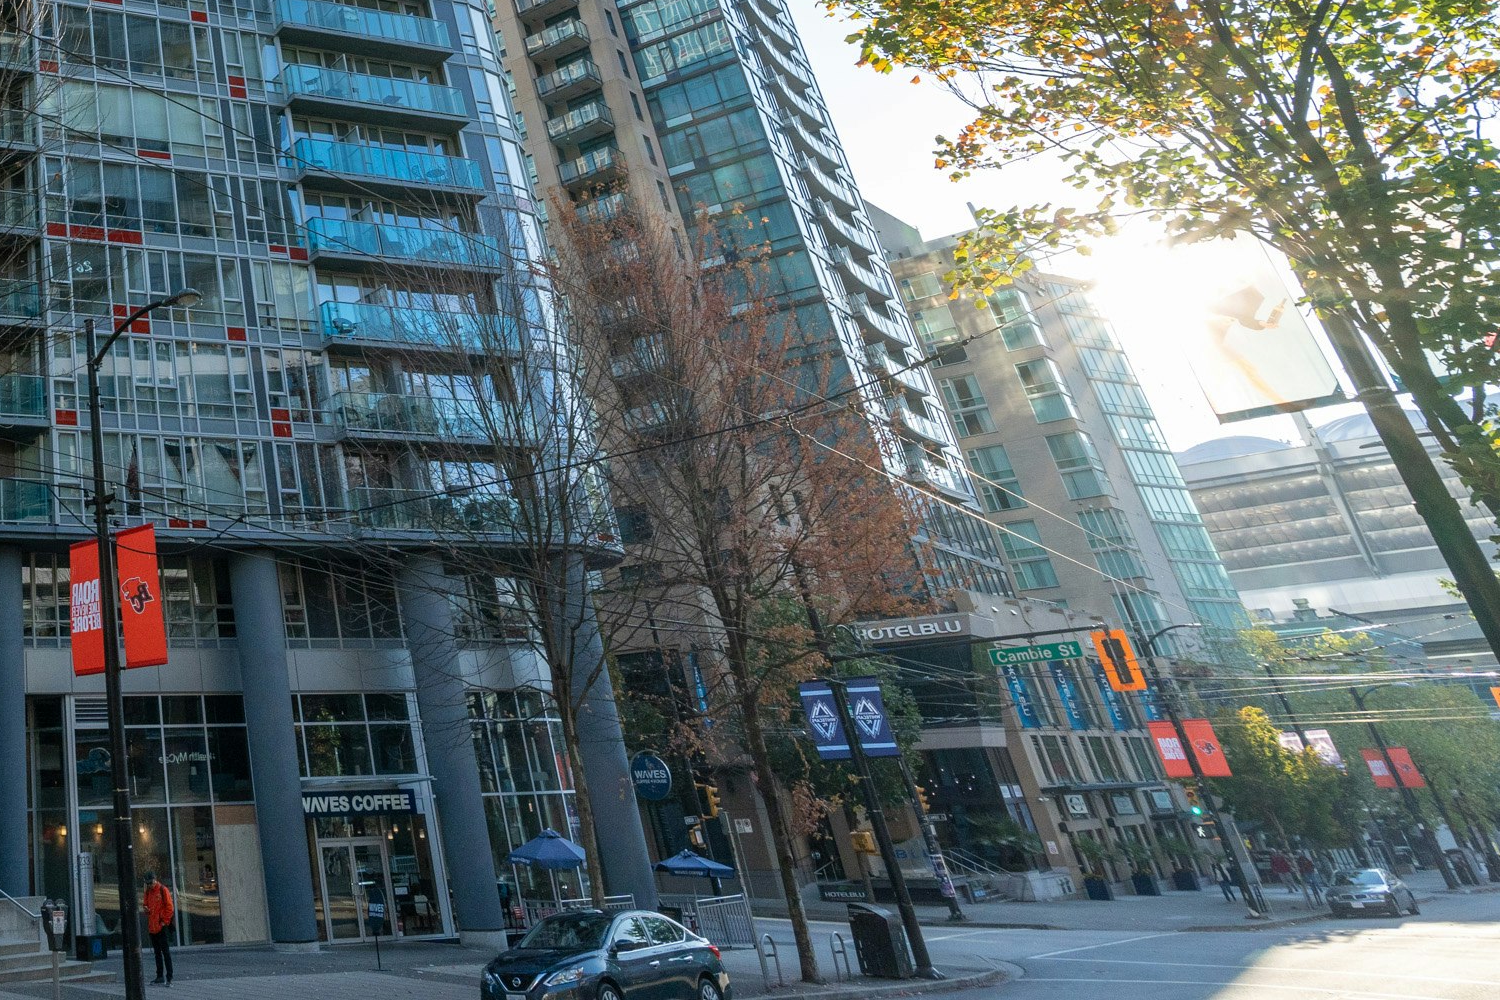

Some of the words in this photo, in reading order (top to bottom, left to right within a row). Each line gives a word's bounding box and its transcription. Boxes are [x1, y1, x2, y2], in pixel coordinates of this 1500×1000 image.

[996, 647, 1053, 663] Cambie
[1058, 644, 1077, 657] St
[634, 769, 668, 779] WAVES
[351, 793, 411, 812] COFFEE
